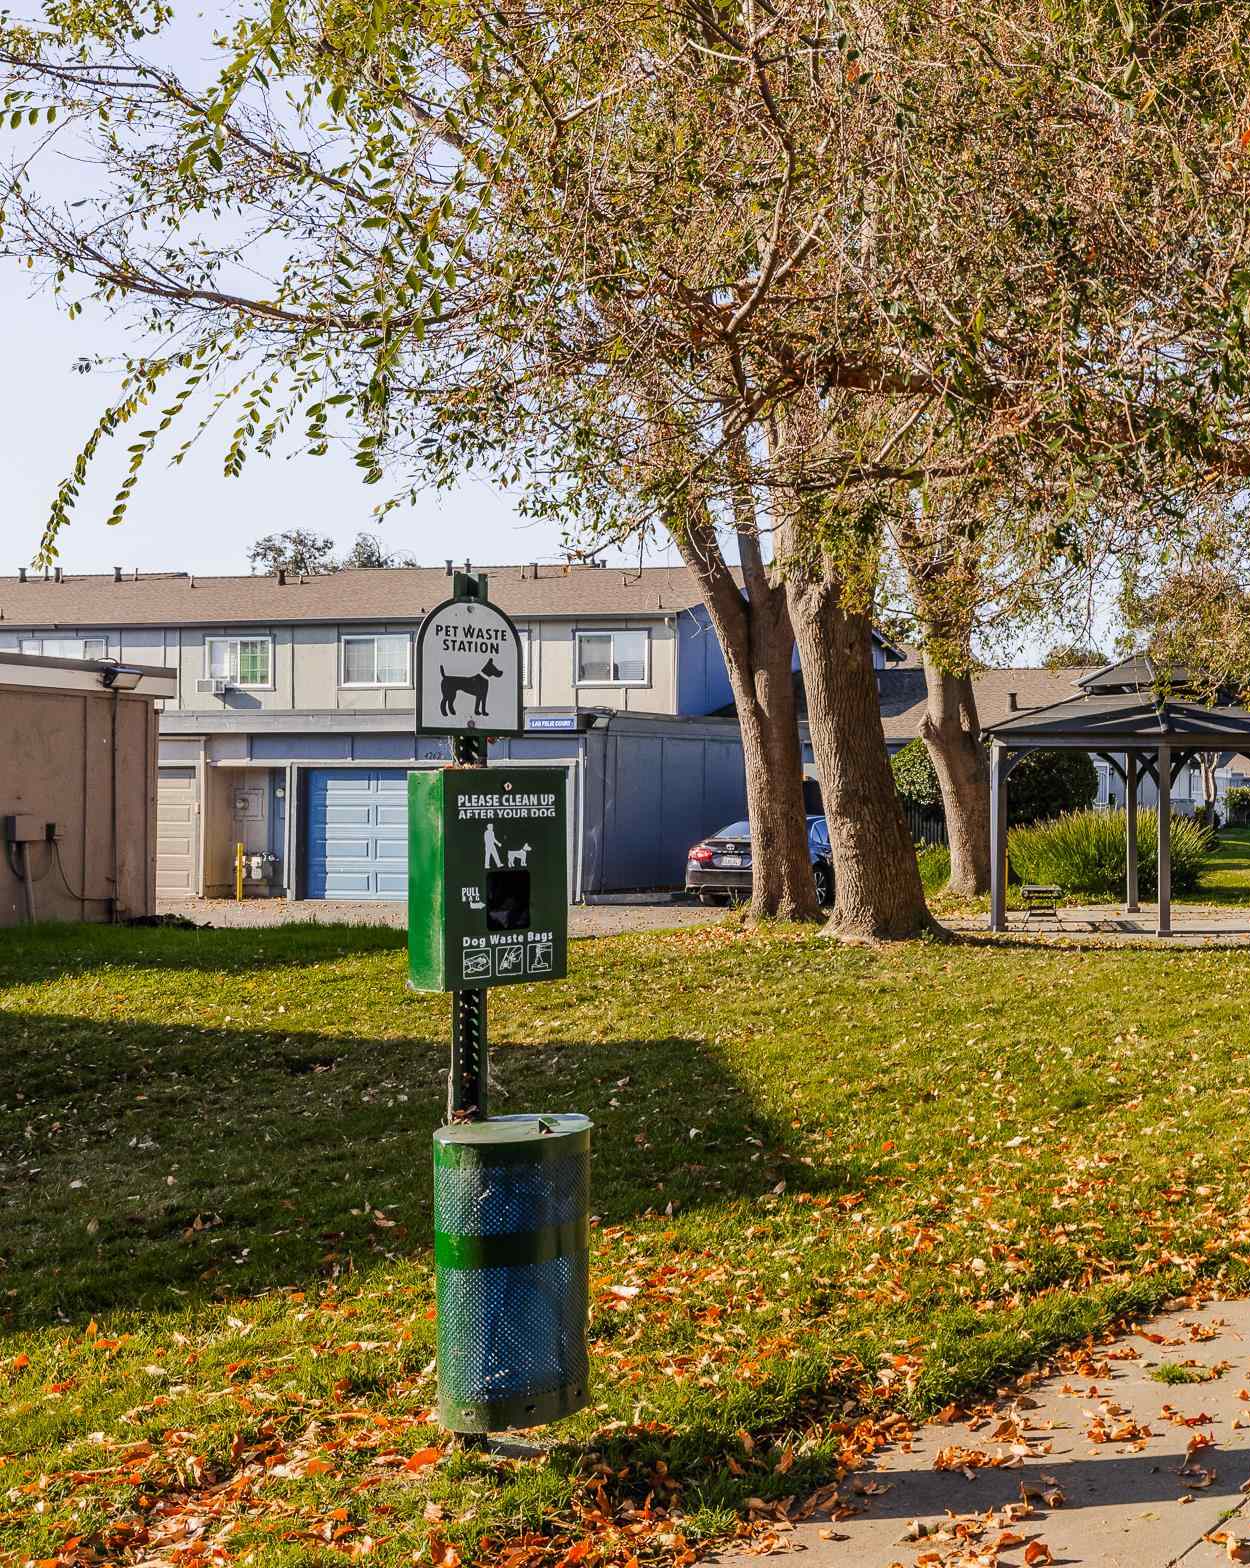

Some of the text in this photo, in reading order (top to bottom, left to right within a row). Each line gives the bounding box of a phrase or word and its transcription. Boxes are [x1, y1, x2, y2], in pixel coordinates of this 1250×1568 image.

[436, 624, 507, 641] PET WASTE
[443, 638, 499, 654] STATION
[457, 794, 556, 807] PLEASE CLEAN UP
[458, 808, 556, 819] AFTER YOUR DOG
[461, 887, 480, 897] PULL
[462, 931, 553, 947] Dog Waste Bags
